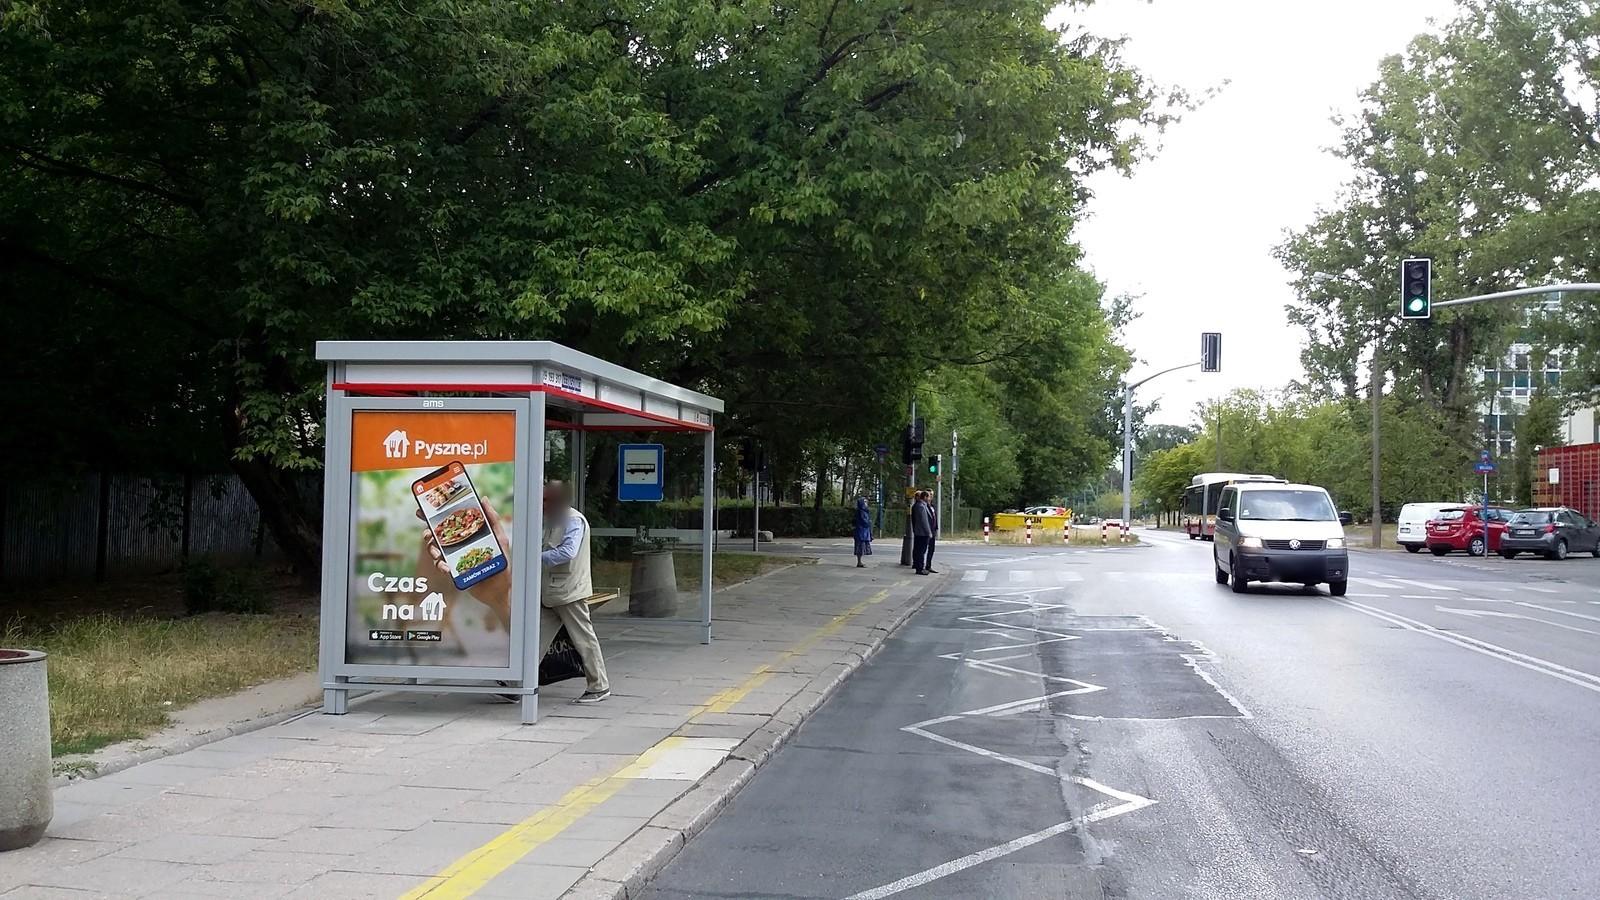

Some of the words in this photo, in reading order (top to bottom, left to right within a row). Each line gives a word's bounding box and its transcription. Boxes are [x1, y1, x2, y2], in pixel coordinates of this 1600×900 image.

[423, 400, 444, 408] ams
[414, 440, 487, 459] Pyszne.pl
[368, 572, 428, 593] Czas
[463, 571, 482, 583] ZAMÓW
[481, 563, 496, 574] TERAZ
[382, 603, 414, 620] na
